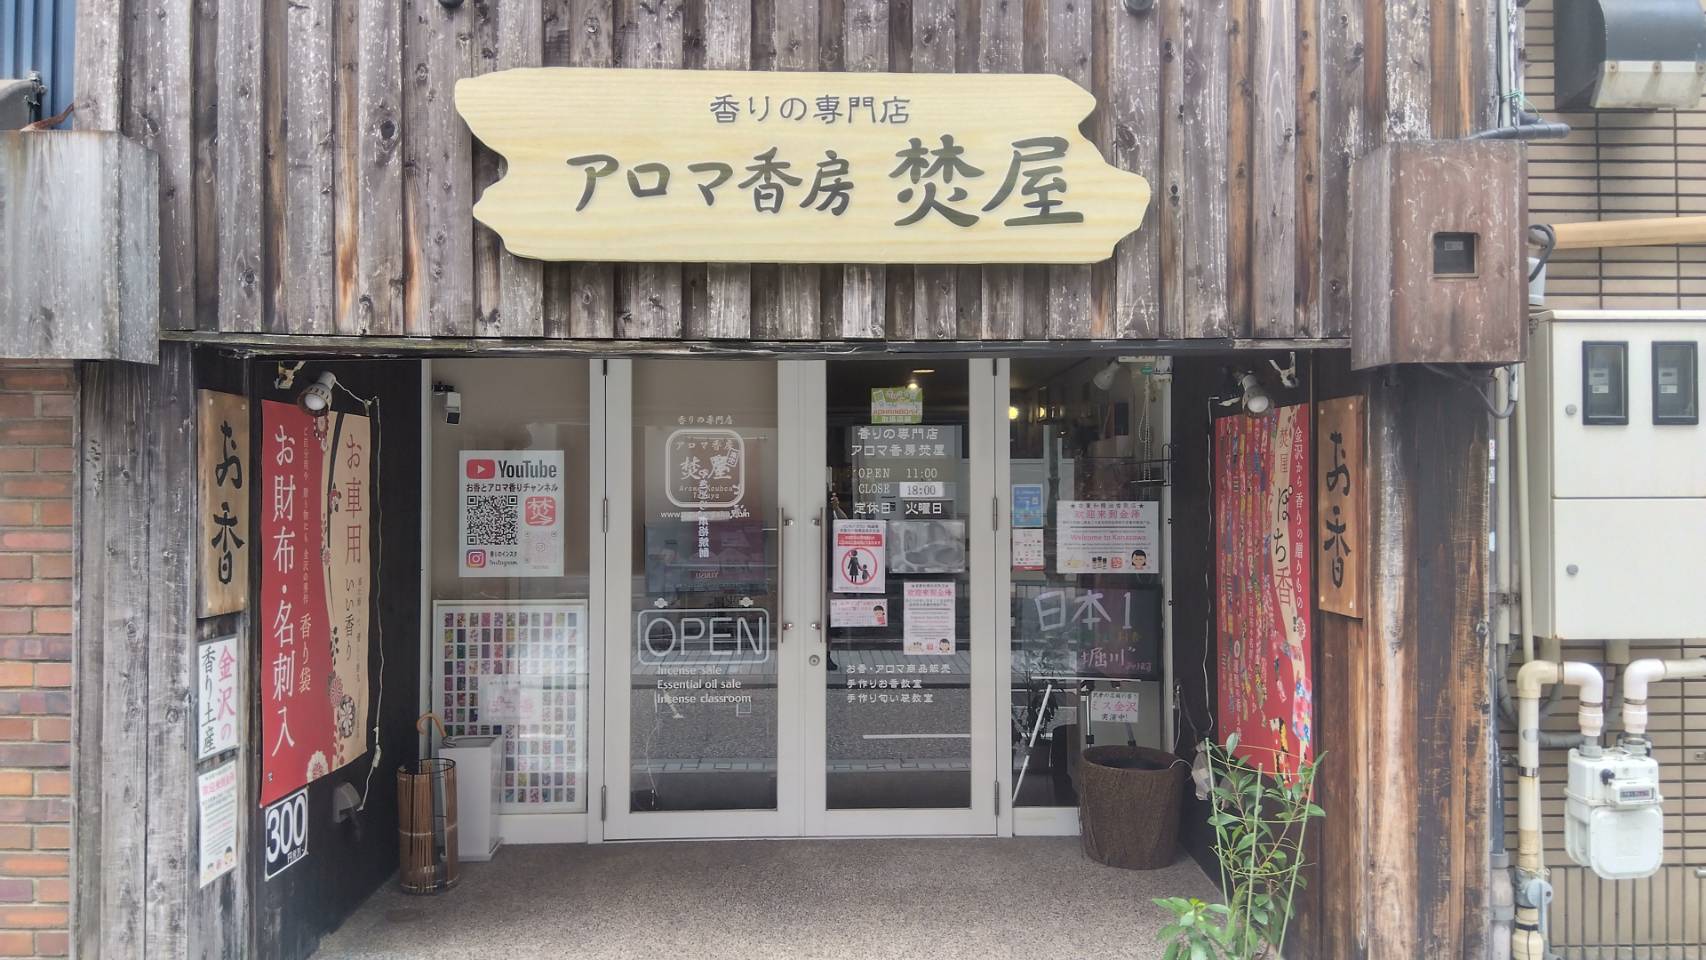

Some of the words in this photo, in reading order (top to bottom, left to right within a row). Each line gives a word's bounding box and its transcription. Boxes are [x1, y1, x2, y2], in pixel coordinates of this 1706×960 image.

[709, 94, 911, 125] 香りの専門店
[566, 146, 854, 217] アロマ香房
[889, 134, 1085, 228] 焚屋
[678, 415, 733, 425] 香りの専門店
[858, 428, 938, 440] 香りの専門店
[851, 444, 945, 456] アロマ香房焚屋
[497, 460, 557, 478] YouTube
[858, 468, 890, 479] OPEN
[906, 468, 937, 478] 11:00
[466, 482, 558, 492] お香とアロマ香りチャンネル
[858, 483, 890, 494] CLOSE
[907, 485, 936, 496] 18:00
[211, 420, 245, 585] お香
[345, 434, 362, 566] お車用
[854, 502, 891, 514] 定休日
[905, 502, 942, 514] 火曜日
[1324, 431, 1351, 589] お香
[1273, 484, 1294, 606] ぽち香
[1295, 492, 1304, 609] 香りの贈りもの
[272, 425, 296, 758] お財布・名刺入
[645, 617, 762, 656] OPEN
[299, 613, 312, 694] 香り袋
[701, 665, 722, 675] sale
[846, 664, 951, 673] お香・アロマ商品販売
[216, 645, 236, 742] 金沢の
[657, 679, 702, 689] Essential
[705, 679, 718, 689] oil
[721, 679, 742, 689] sale
[846, 679, 923, 689] 手作りお香教室
[202, 648, 216, 754] 香り土産
[700, 694, 751, 703] classroom
[267, 795, 306, 863] 300
